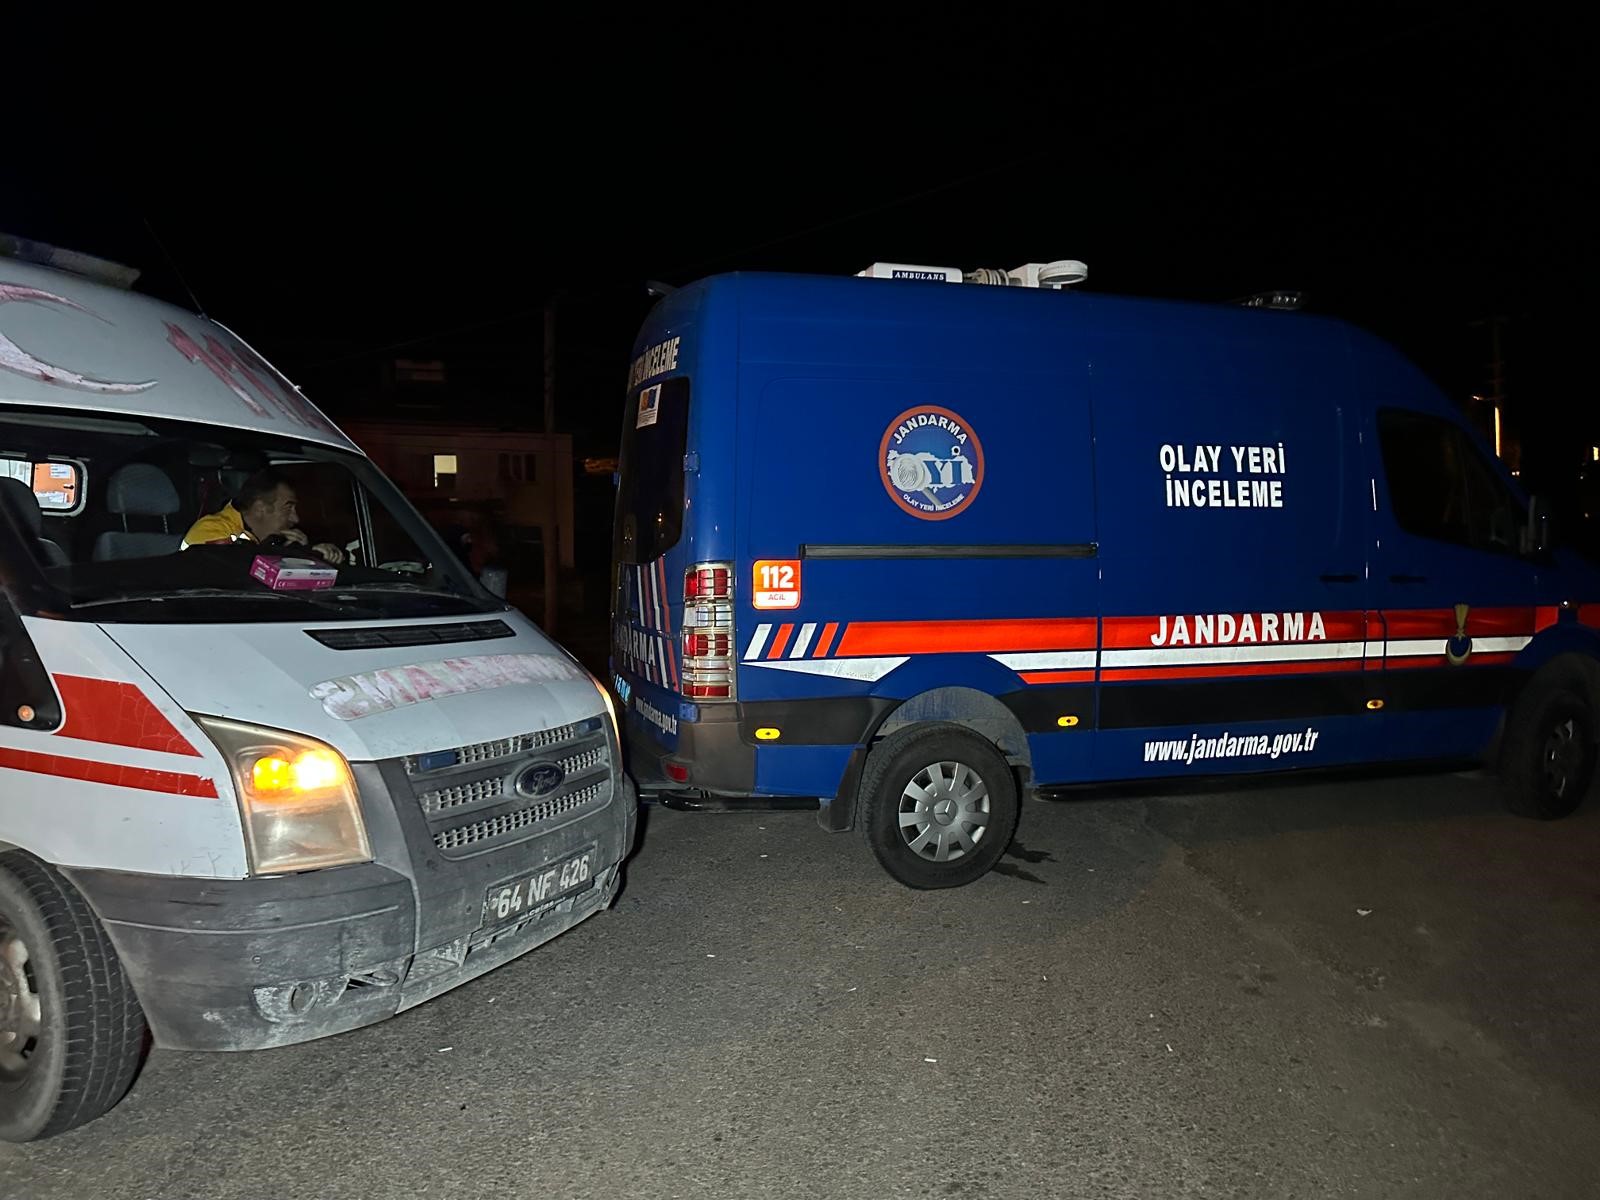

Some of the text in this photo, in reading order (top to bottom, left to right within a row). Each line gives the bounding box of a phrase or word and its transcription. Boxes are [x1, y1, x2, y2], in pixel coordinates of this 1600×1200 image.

[894, 271, 946, 281] AMBULANS
[893, 414, 968, 445] JANDARMA
[1159, 442, 1286, 474] OLAY YERİ
[903, 493, 919, 507] OLAY
[1165, 473, 1283, 508] İNCELEME
[760, 565, 794, 589] 112
[1150, 612, 1327, 647] JANDARMA
[1143, 728, 1319, 765] www.jandarma.gov.tr
[497, 885, 522, 919] 64
[527, 869, 557, 906] NF
[559, 854, 590, 890] 426
